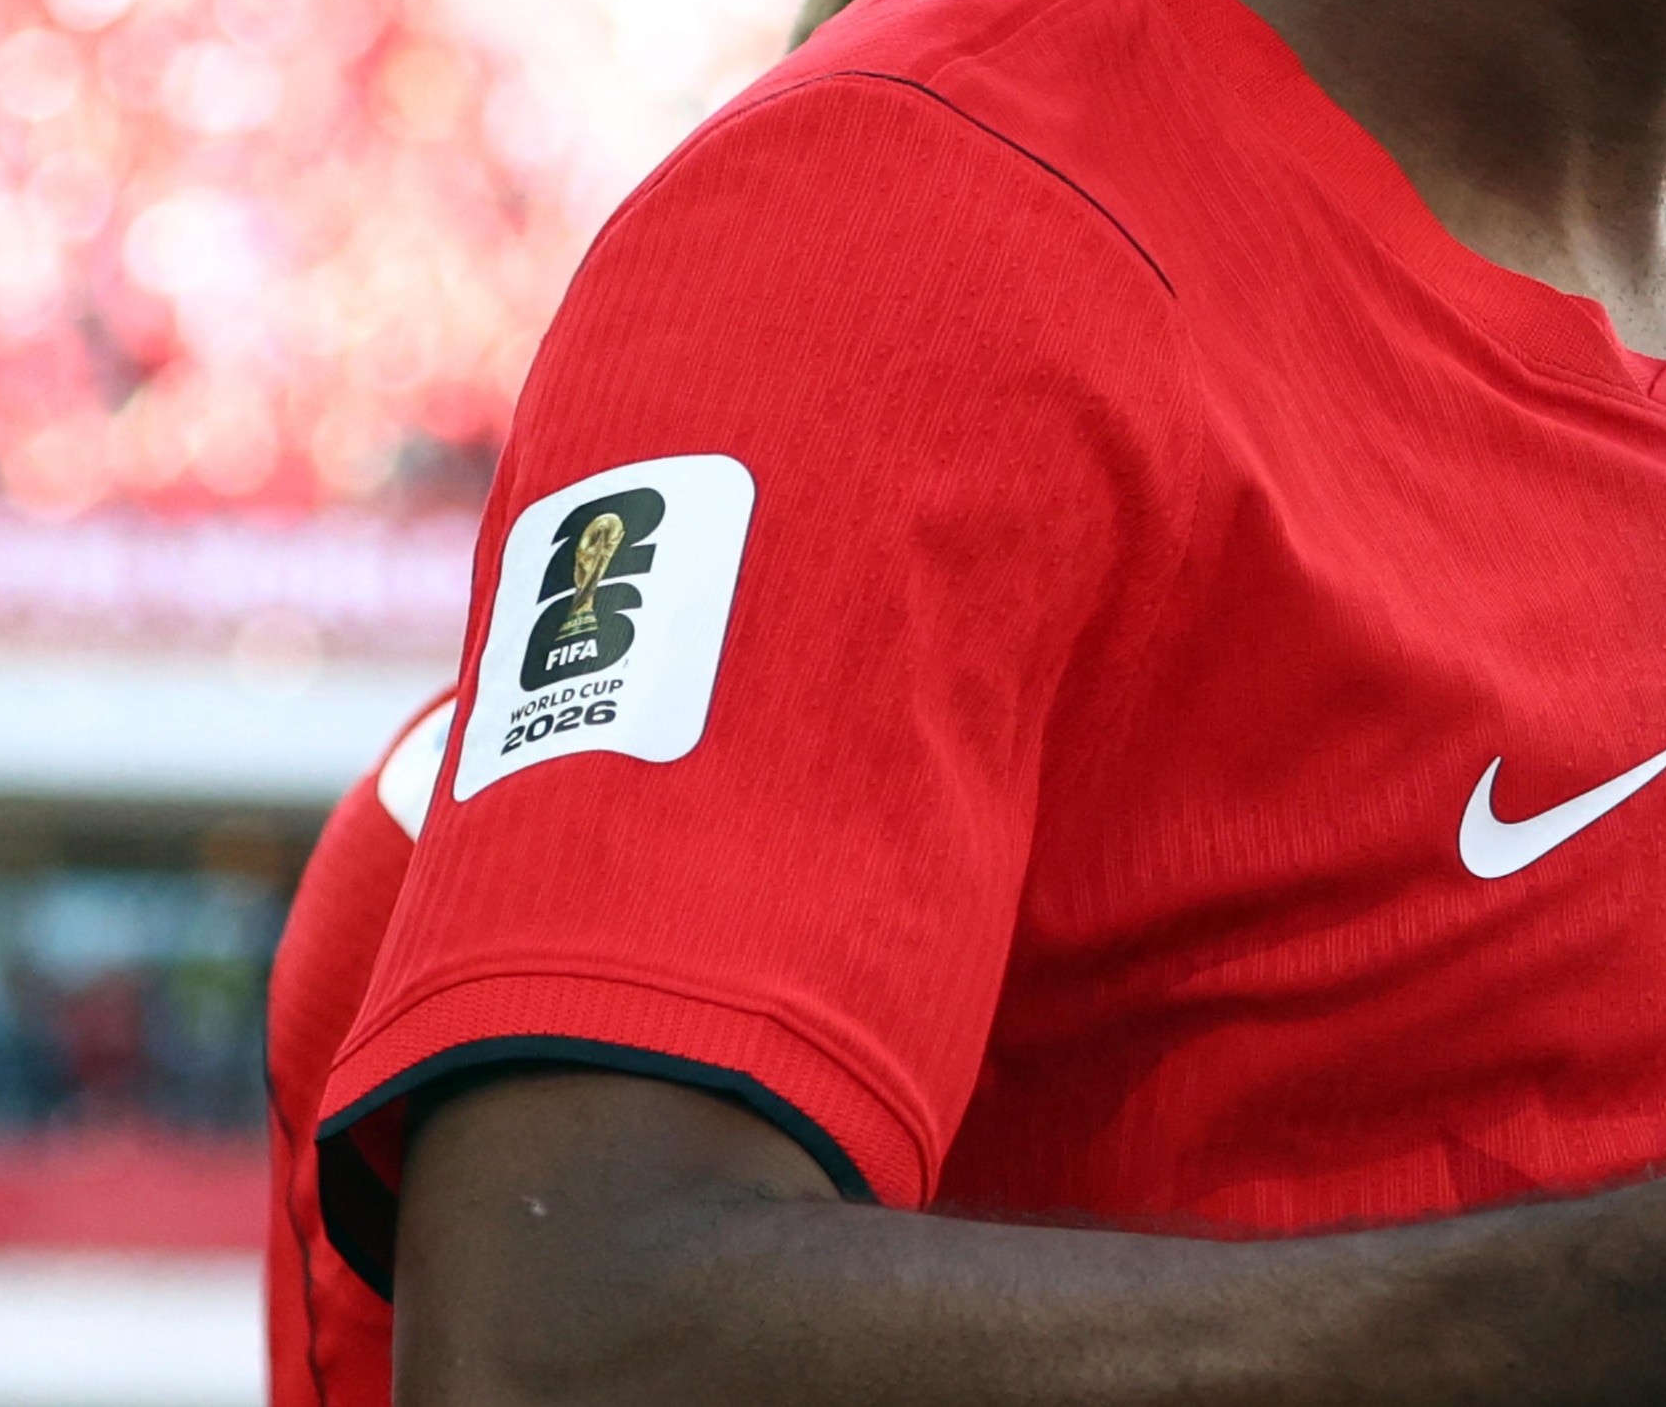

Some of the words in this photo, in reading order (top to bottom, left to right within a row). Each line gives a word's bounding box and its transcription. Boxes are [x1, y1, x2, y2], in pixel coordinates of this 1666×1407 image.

[545, 638, 598, 671] FIFA
[510, 688, 576, 725] WORLD
[579, 679, 624, 699] CUP
[500, 700, 618, 756] 2026
